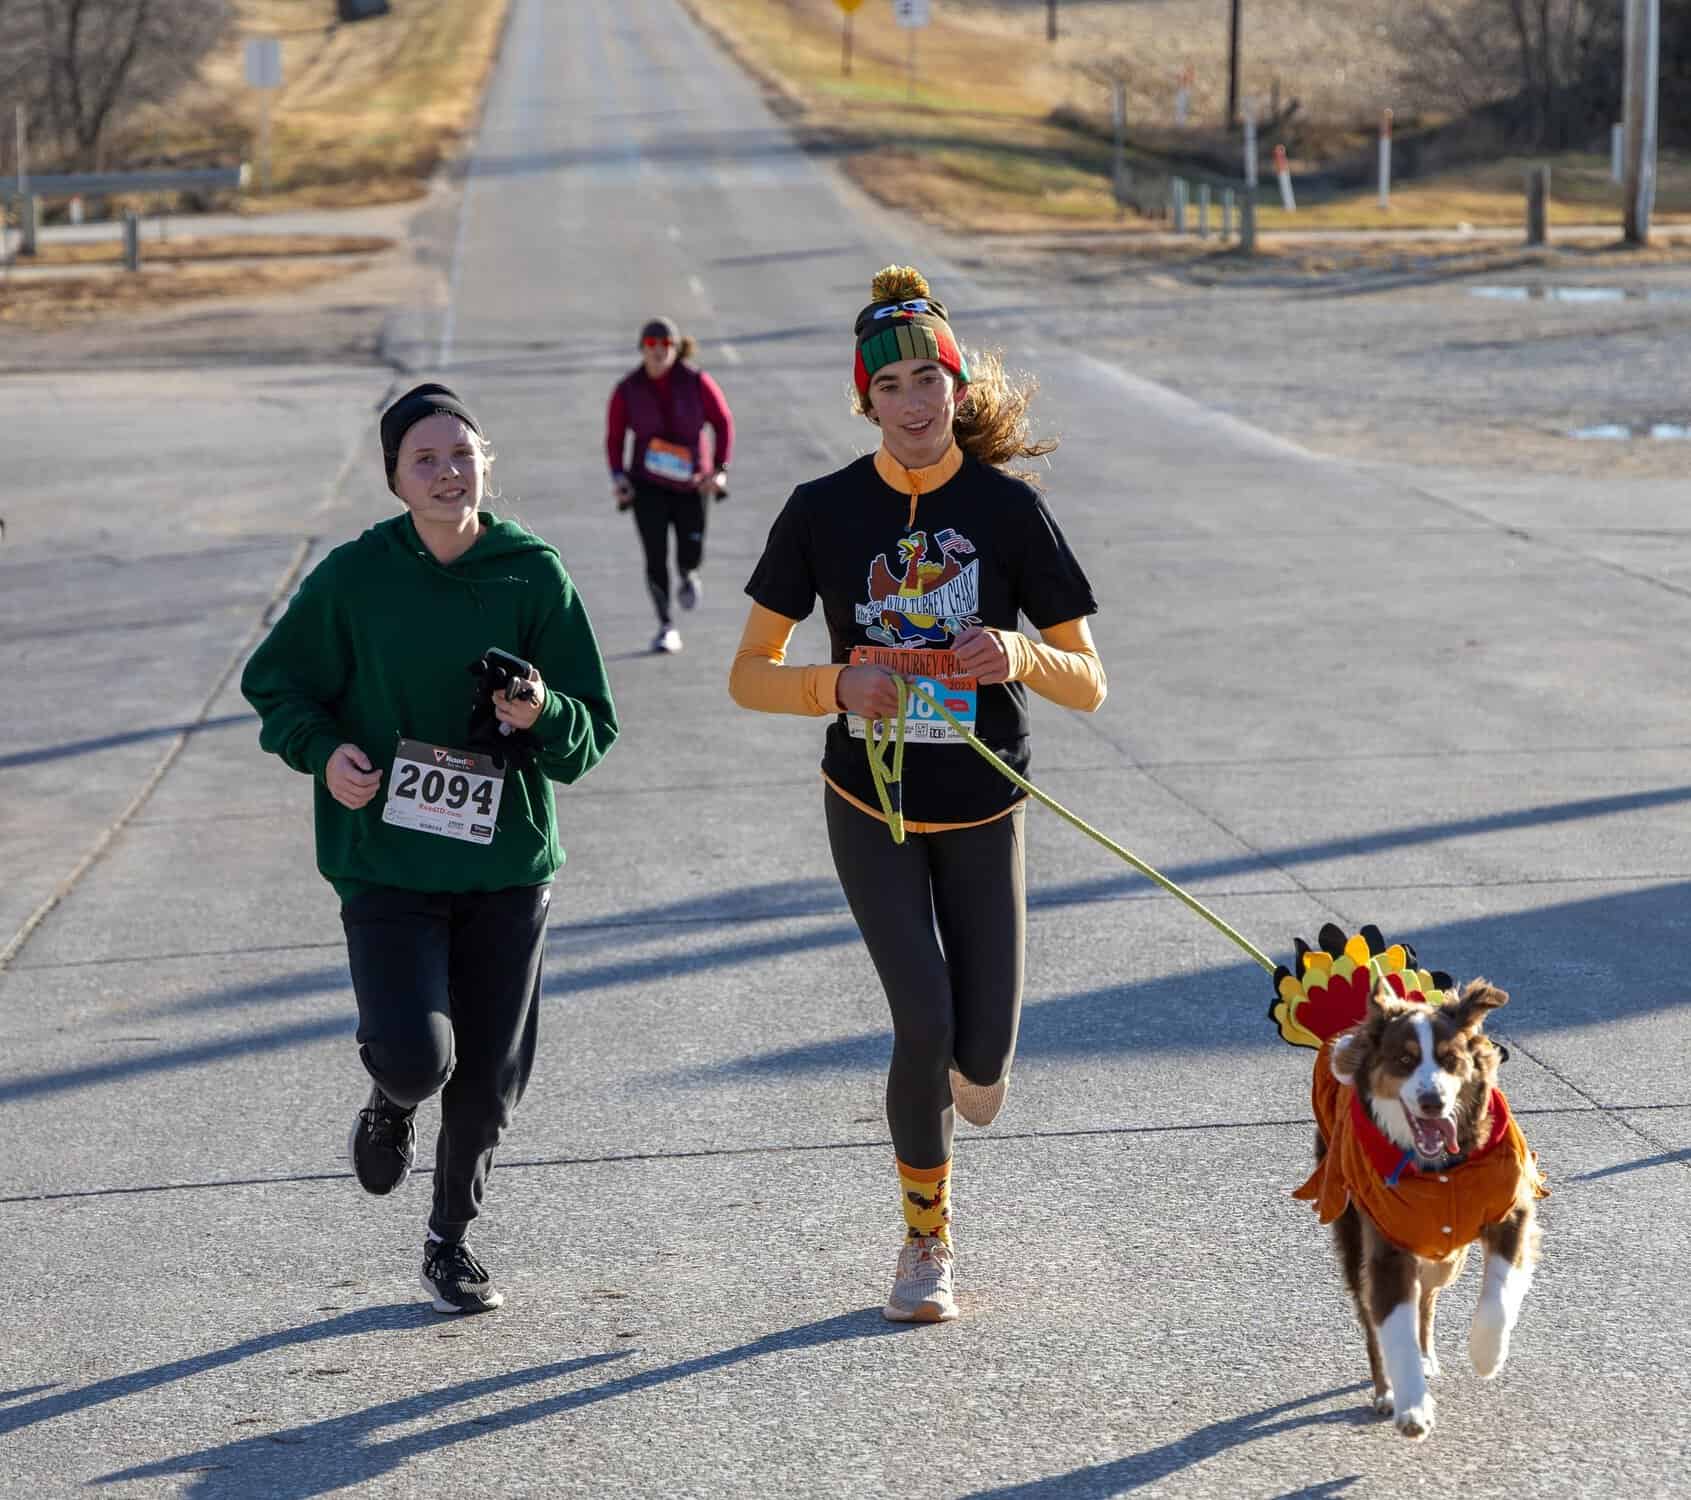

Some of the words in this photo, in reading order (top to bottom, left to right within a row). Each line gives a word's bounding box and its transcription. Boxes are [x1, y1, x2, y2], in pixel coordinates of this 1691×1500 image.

[886, 596, 907, 611] WILD
[910, 588, 945, 616] TURKEY
[897, 652, 939, 676] TURKEY
[395, 764, 493, 815] 2094
